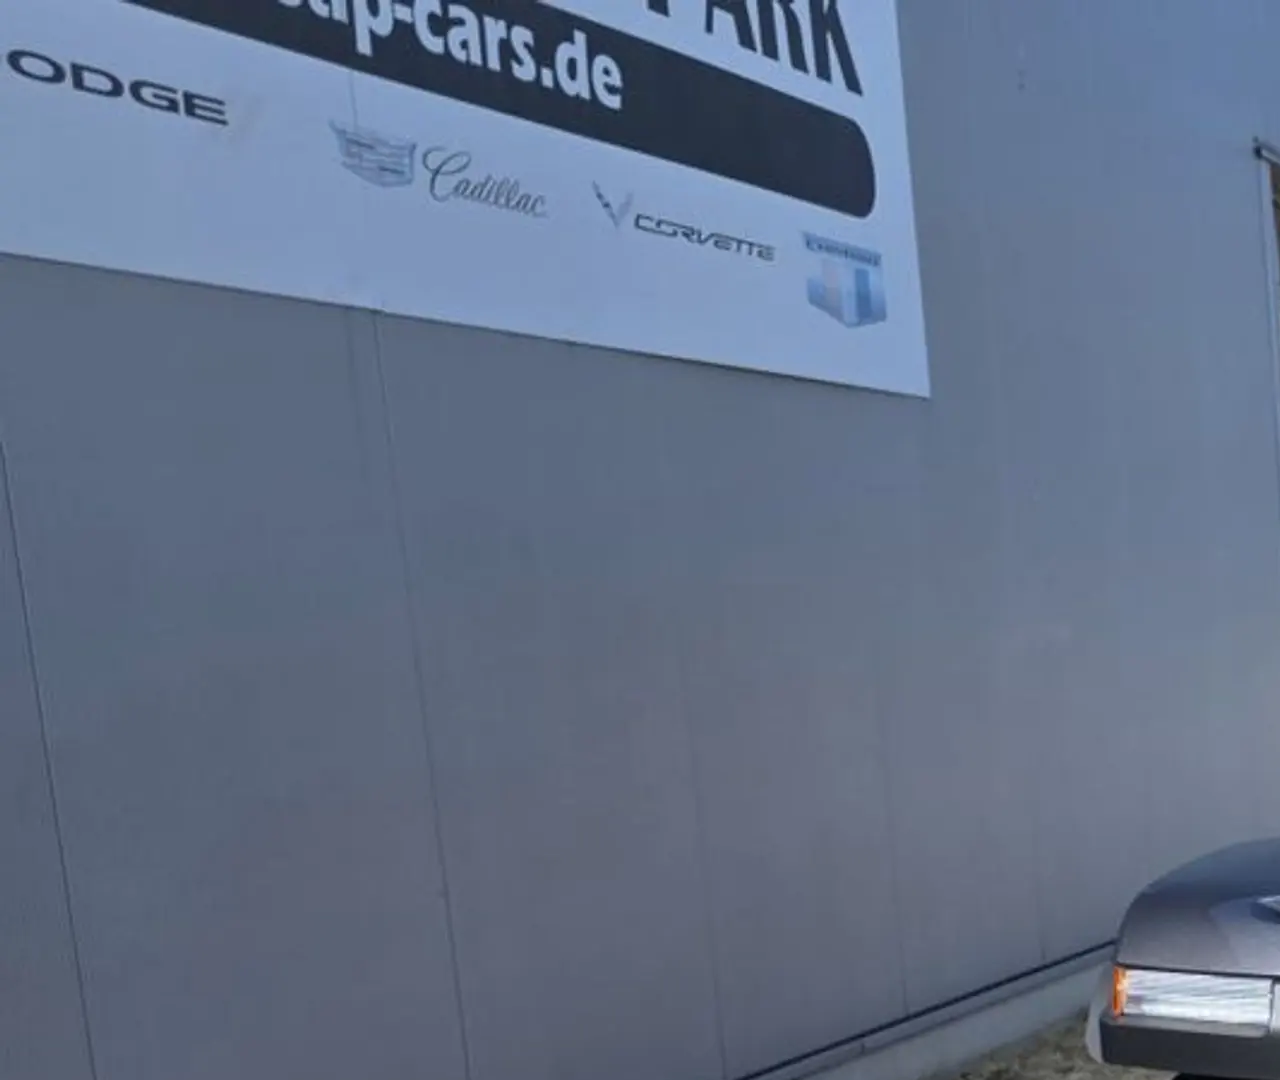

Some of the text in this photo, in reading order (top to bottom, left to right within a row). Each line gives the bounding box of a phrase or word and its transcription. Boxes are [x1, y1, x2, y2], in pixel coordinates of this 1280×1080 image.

[6, 49, 229, 127] ODGE
[276, 0, 623, 110] p-cars.de
[422, 146, 548, 217] Cadillac
[634, 213, 776, 262] CORVETTE
